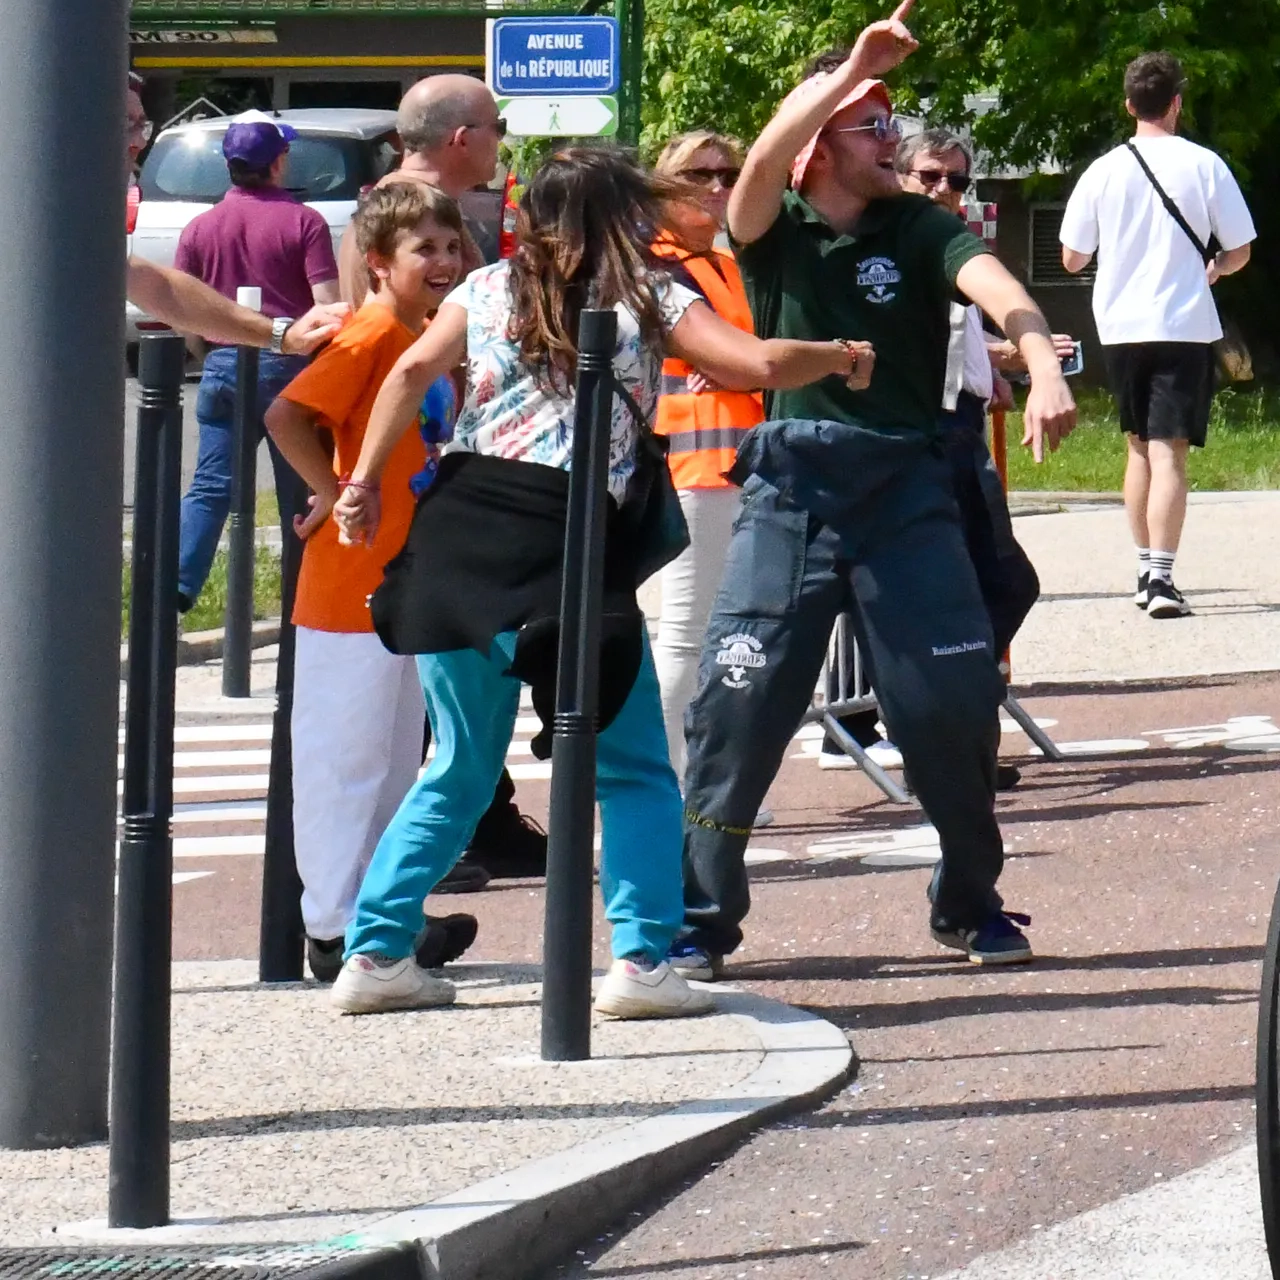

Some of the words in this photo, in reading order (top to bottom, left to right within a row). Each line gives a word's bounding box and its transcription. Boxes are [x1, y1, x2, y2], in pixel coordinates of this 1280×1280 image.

[527, 34, 584, 50] AVENUE
[500, 61, 513, 78] de
[515, 61, 527, 78] la
[529, 57, 610, 78] RÉPUBLIQUE
